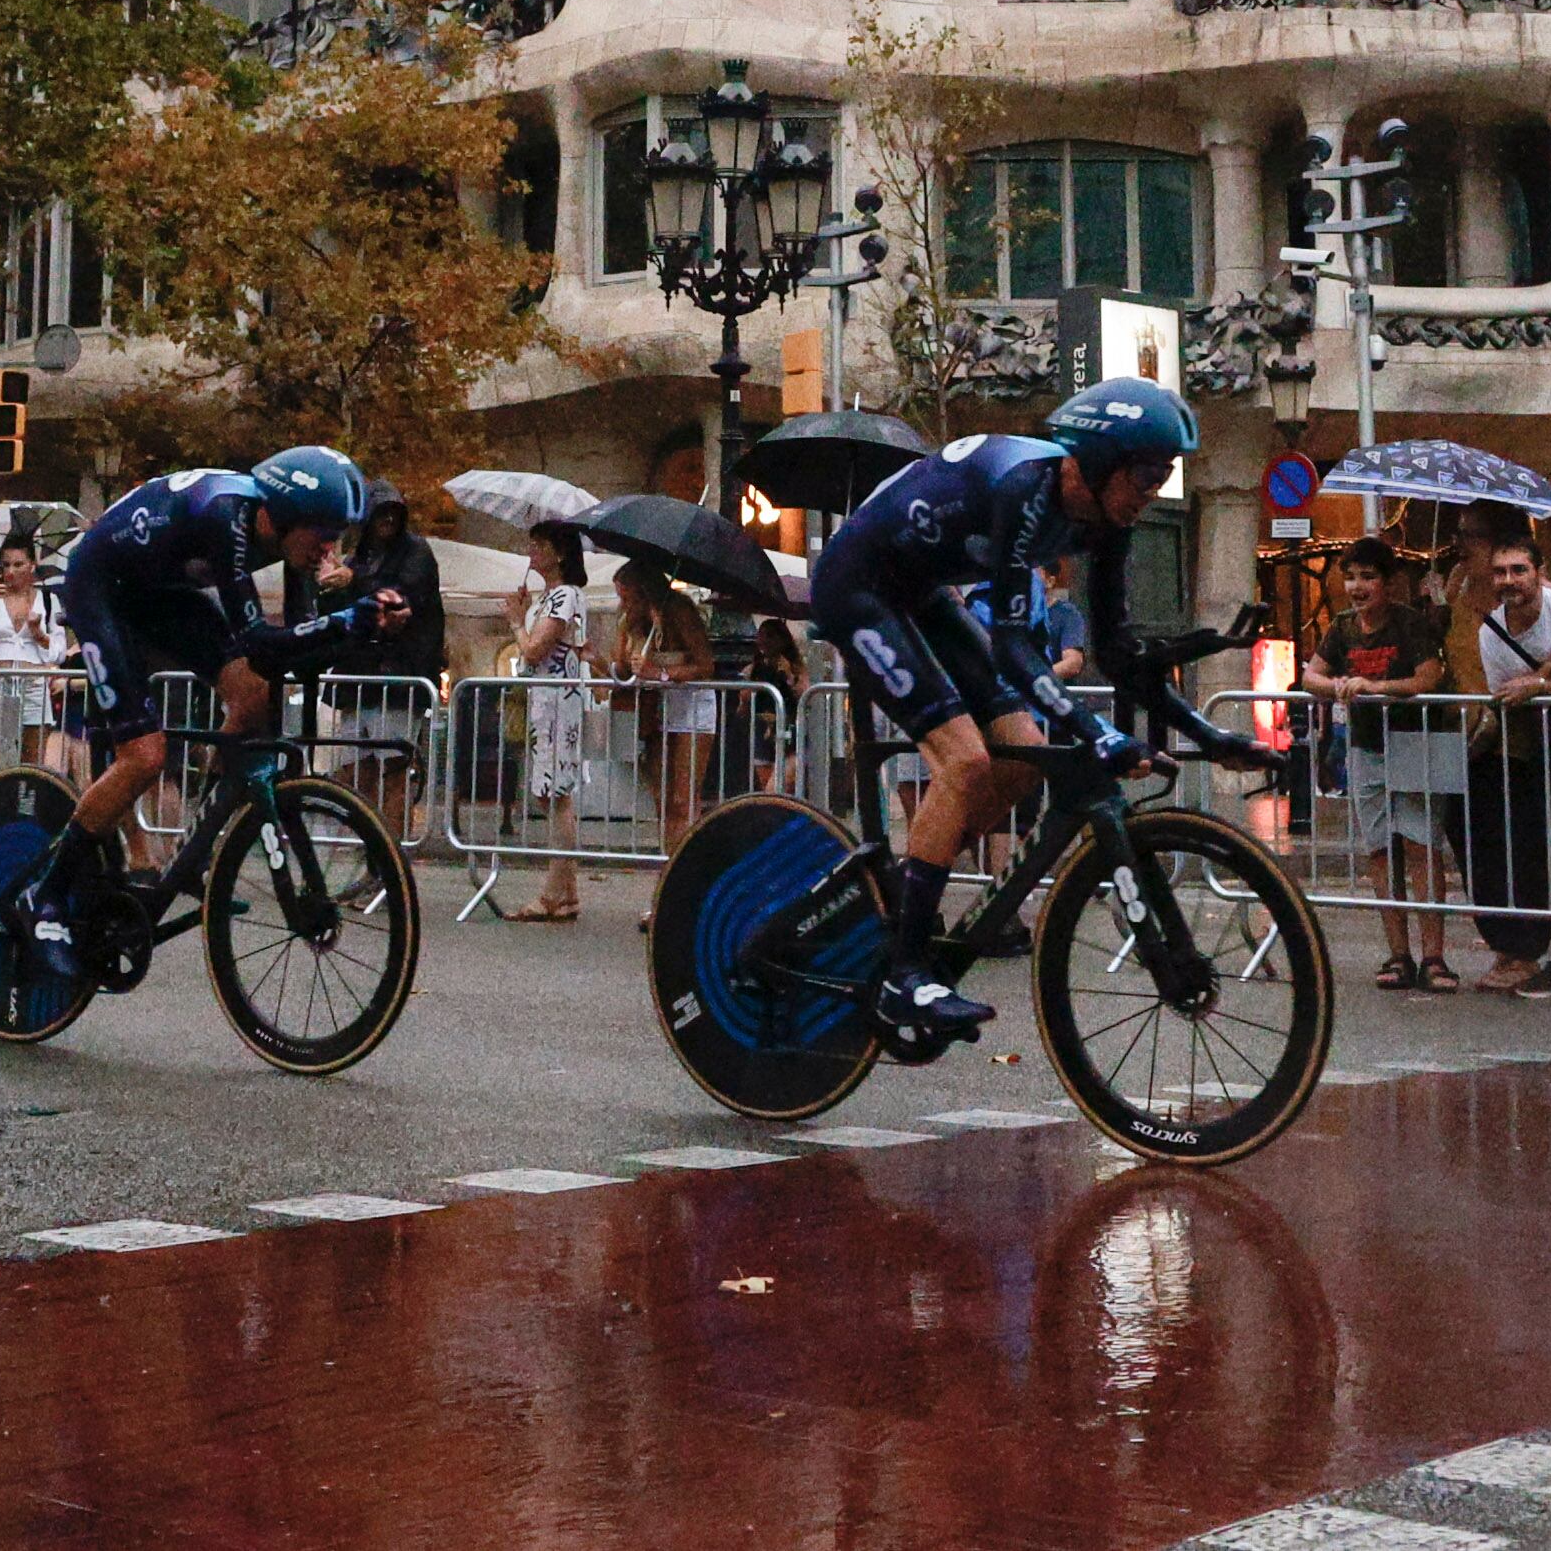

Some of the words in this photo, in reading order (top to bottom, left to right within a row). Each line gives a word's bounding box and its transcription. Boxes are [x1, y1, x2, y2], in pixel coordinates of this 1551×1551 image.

[1073, 342, 1088, 395] rera
[1059, 413, 1114, 431] SCOTT
[1130, 1120, 1201, 1145] syncros
